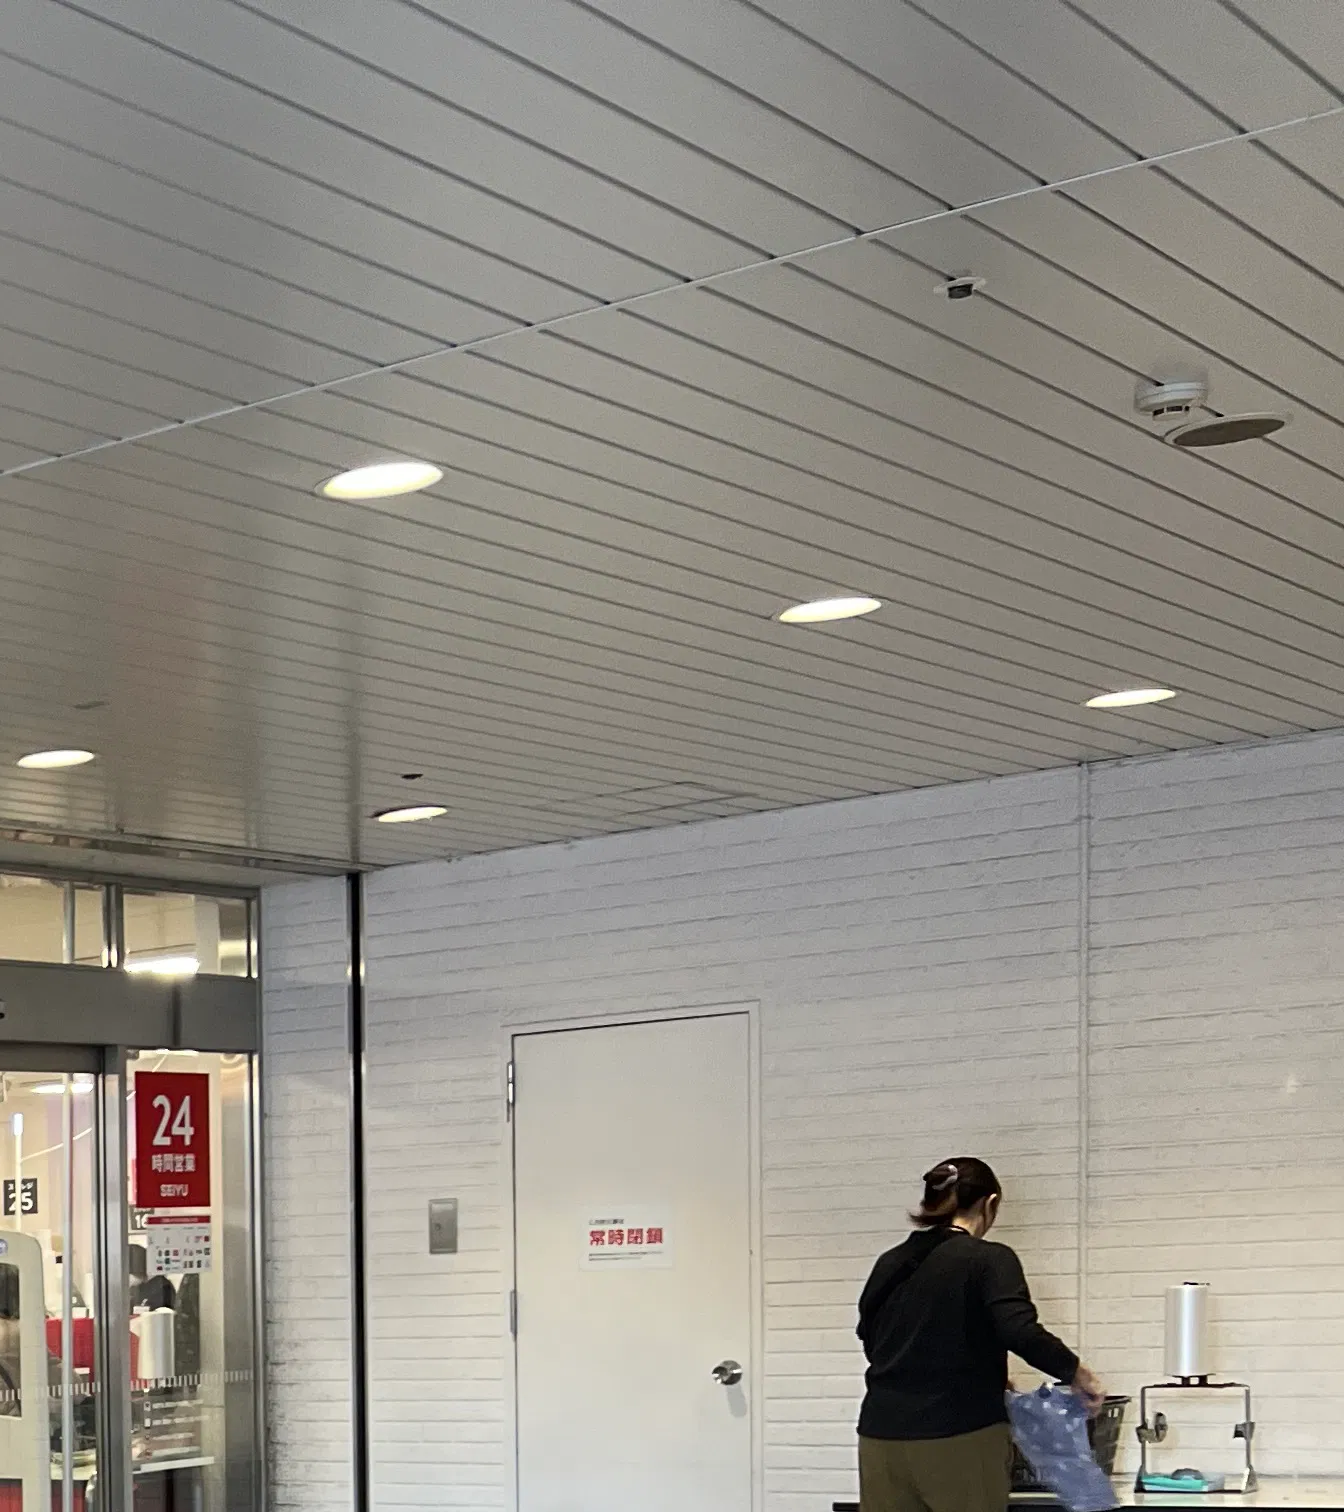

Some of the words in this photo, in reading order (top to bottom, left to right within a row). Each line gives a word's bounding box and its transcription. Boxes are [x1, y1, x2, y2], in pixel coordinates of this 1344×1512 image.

[152, 1095, 195, 1147] 24
[151, 1153, 197, 1173] 時間営業
